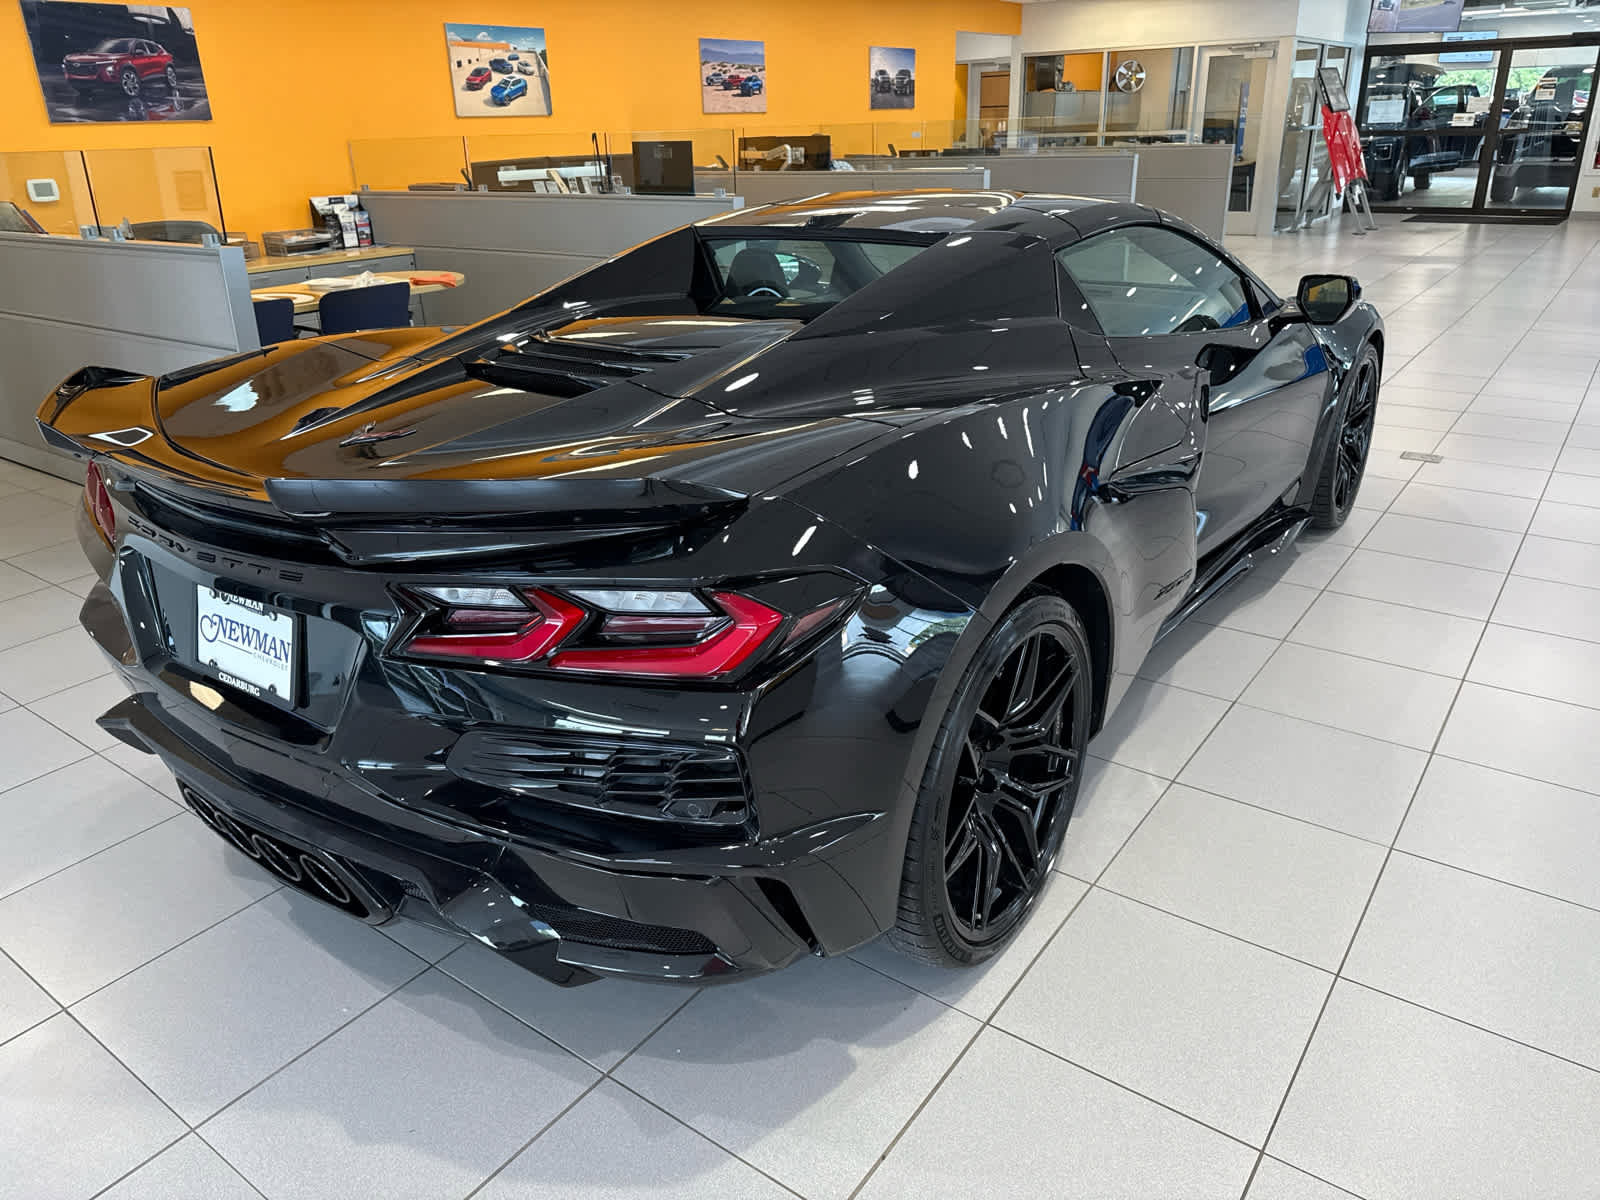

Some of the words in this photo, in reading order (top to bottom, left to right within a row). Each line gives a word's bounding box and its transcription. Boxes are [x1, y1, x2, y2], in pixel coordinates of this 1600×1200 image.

[220, 591, 264, 612] NEWMAN
[200, 613, 292, 663] NEWMAN
[218, 672, 260, 697] CEDARBURG
